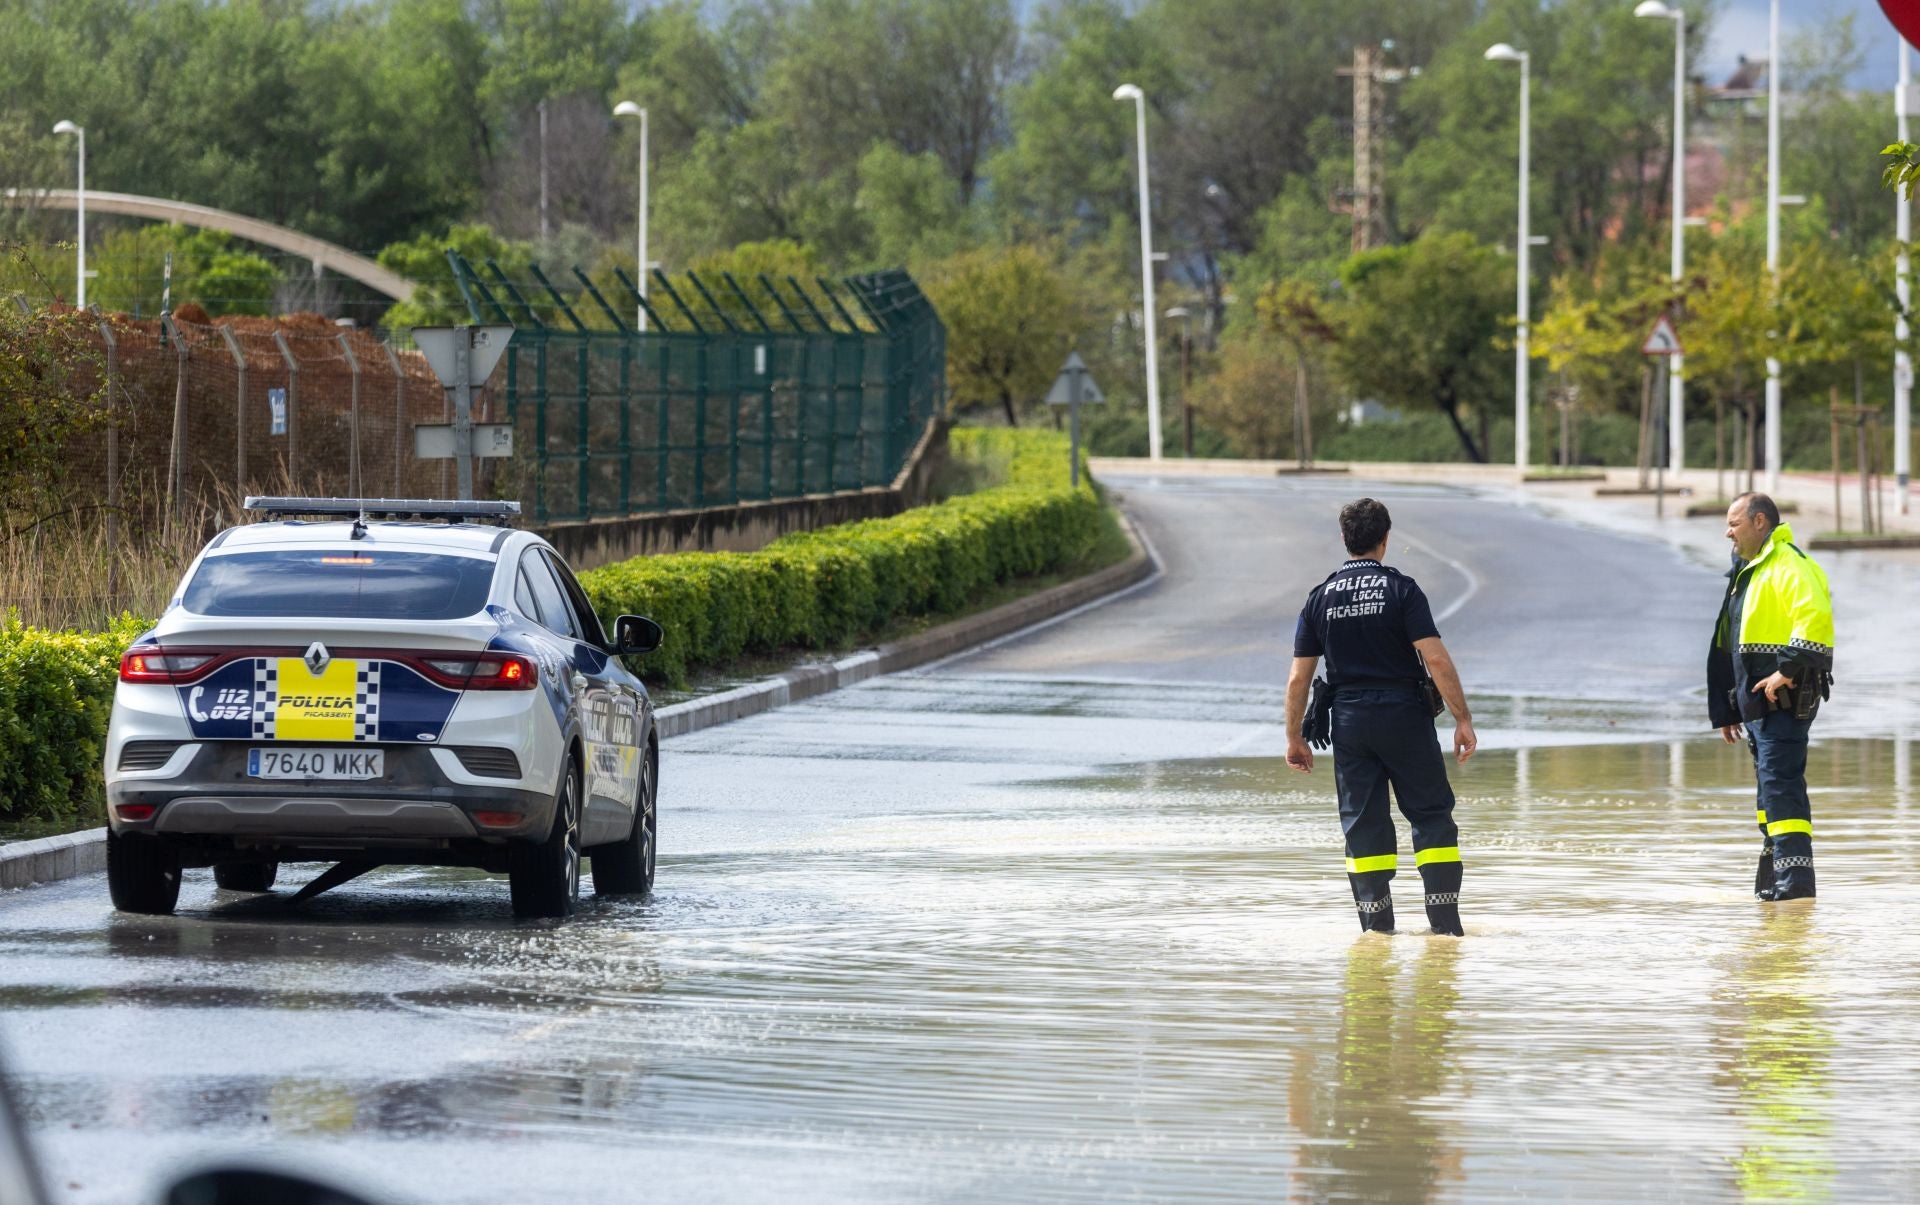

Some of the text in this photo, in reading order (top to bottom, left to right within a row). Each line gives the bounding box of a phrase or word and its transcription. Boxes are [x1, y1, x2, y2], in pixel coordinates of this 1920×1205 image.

[1324, 575, 1388, 595] POLICIA
[1352, 590, 1384, 602] LOCAL
[1326, 602, 1385, 620] PICASSENT
[217, 689, 249, 703] 112
[278, 696, 353, 708] POLICIA
[210, 706, 252, 719] 092
[265, 753, 378, 775] 7640 MKK
